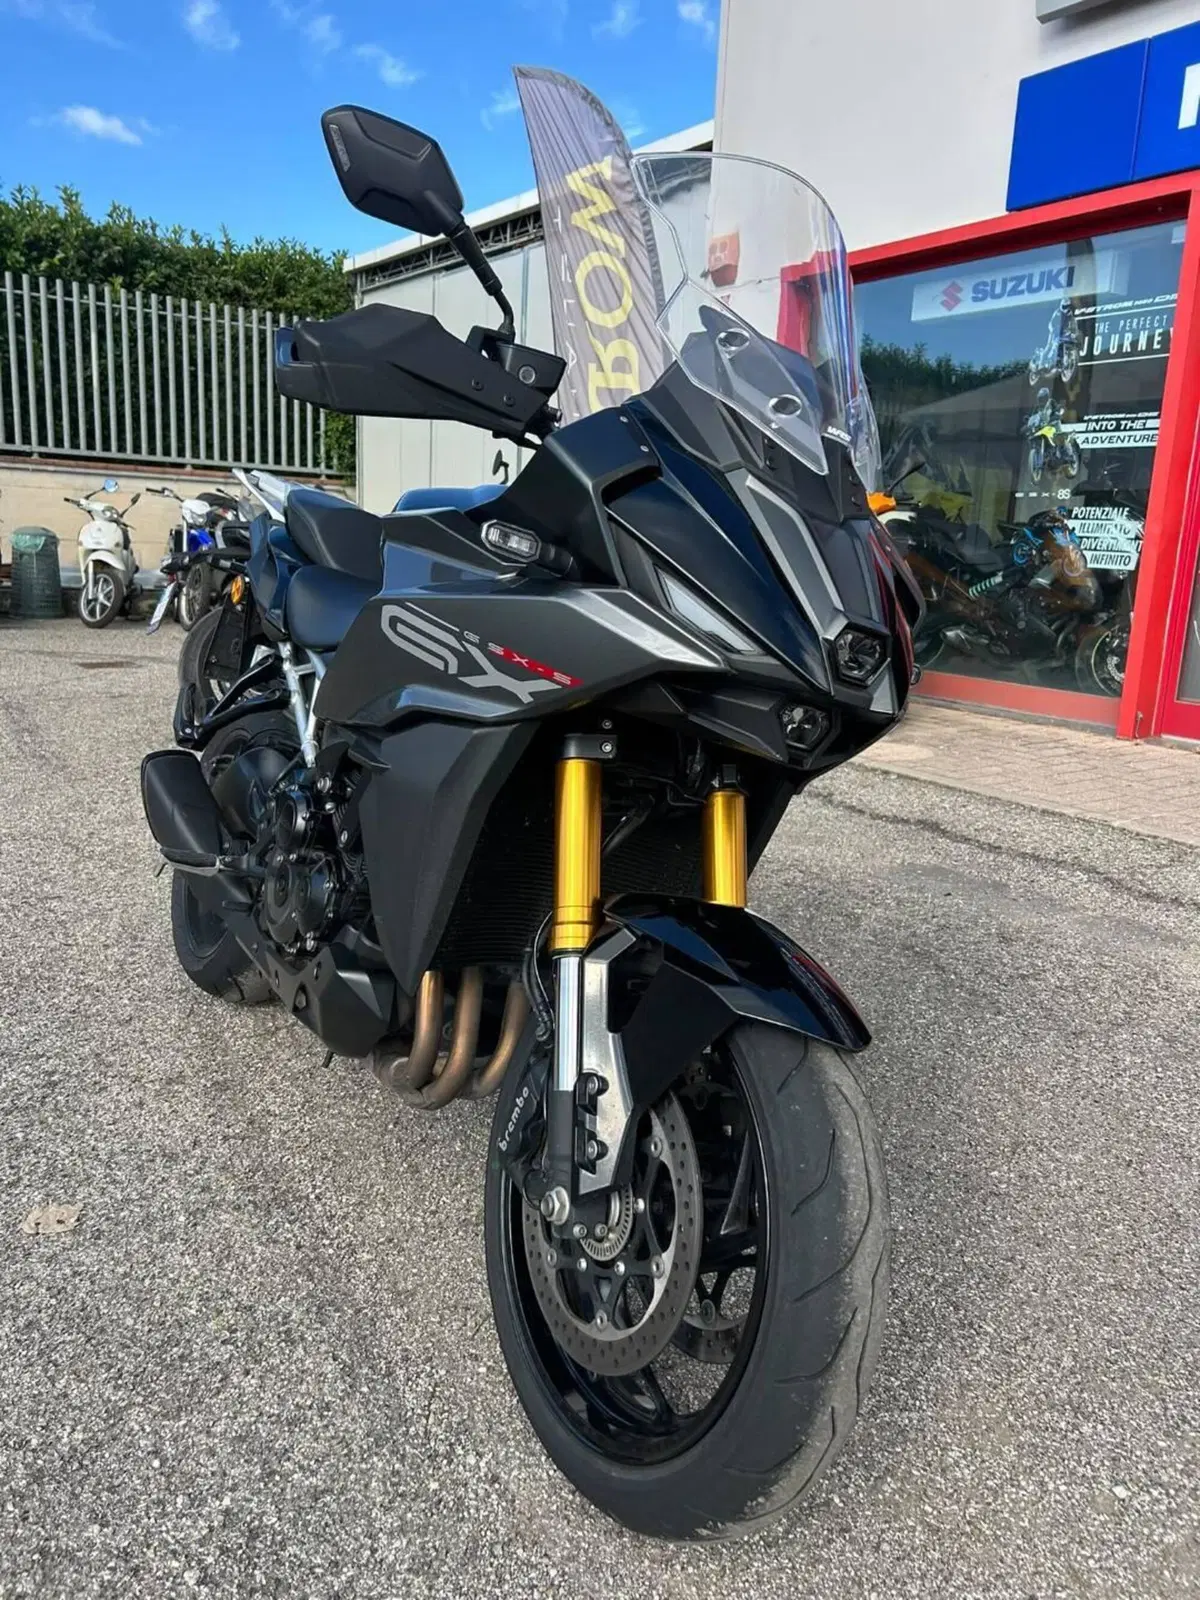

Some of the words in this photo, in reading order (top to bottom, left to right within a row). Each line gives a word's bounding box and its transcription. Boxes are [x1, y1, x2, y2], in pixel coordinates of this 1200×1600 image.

[971, 266, 1075, 302] SUZUKI
[1094, 321, 1110, 334] THE
[1118, 315, 1168, 331] PERFECT
[1087, 420, 1117, 431] INTO
[1120, 420, 1146, 430] THE
[1081, 434, 1159, 445] ADVENTURE
[1071, 506, 1130, 519] POTENZIALE
[1089, 553, 1132, 567] INFINITO
[498, 1086, 529, 1152] brembo
